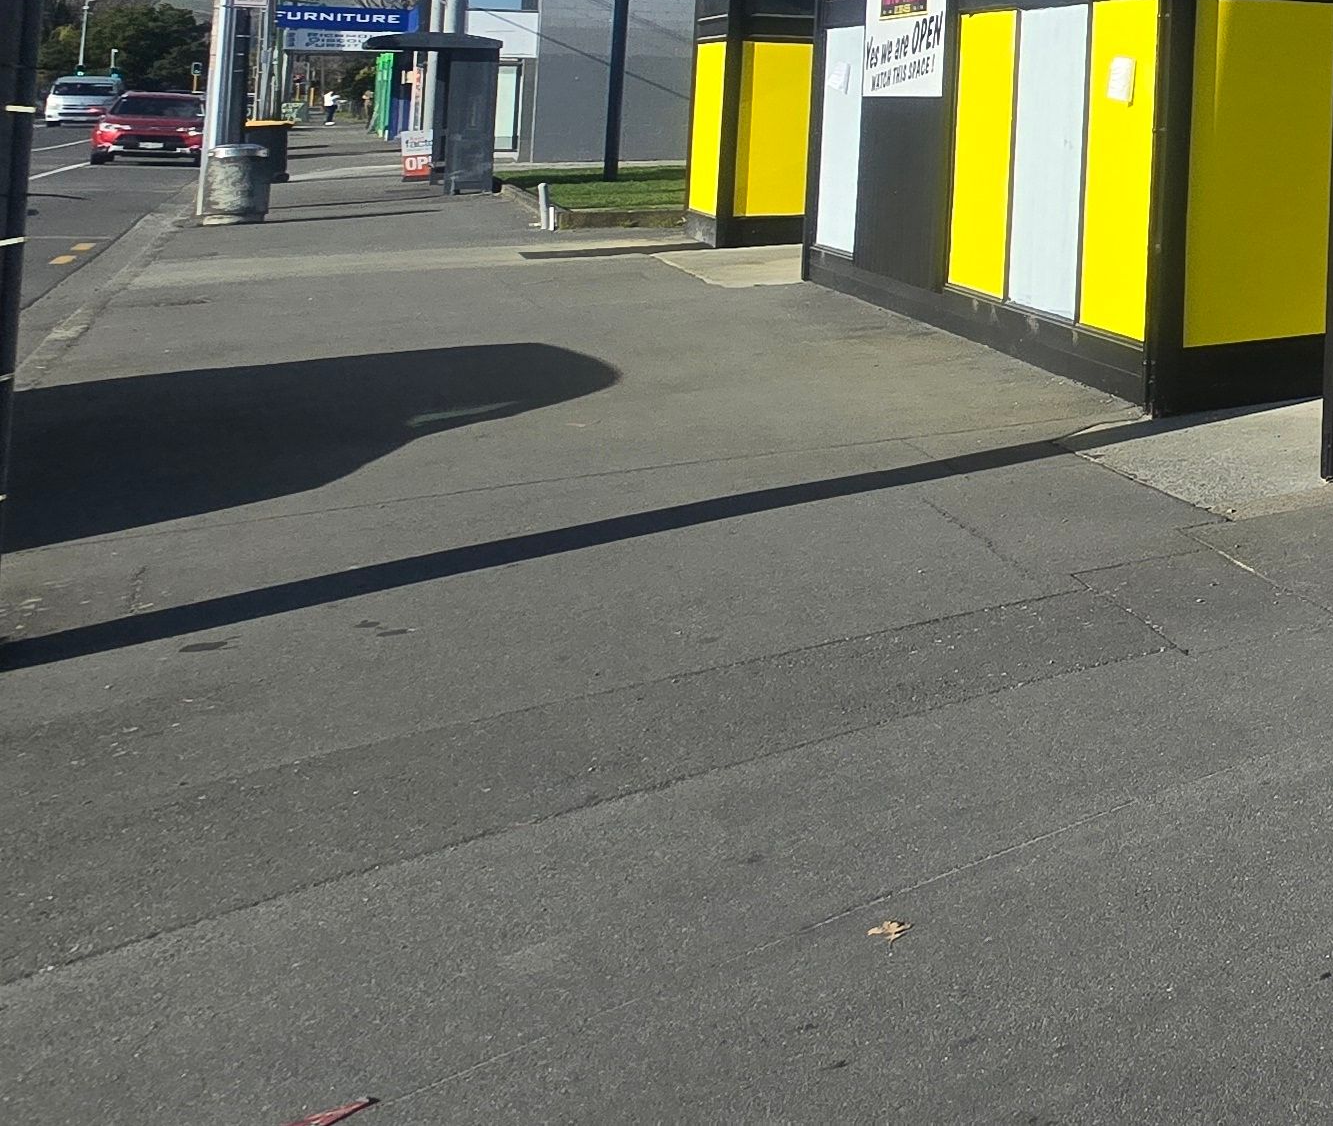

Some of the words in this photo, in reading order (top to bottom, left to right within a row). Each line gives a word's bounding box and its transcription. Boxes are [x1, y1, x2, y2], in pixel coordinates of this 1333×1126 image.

[275, 10, 401, 24] FURNITURE
[865, 35, 880, 71] Yes
[880, 39, 893, 66] we
[894, 34, 910, 61] are
[911, 10, 944, 55] OPEN
[870, 67, 892, 92] WATCH
[892, 61, 907, 84] THIS
[907, 55, 930, 80] SPACE
[405, 156, 430, 171] OP
